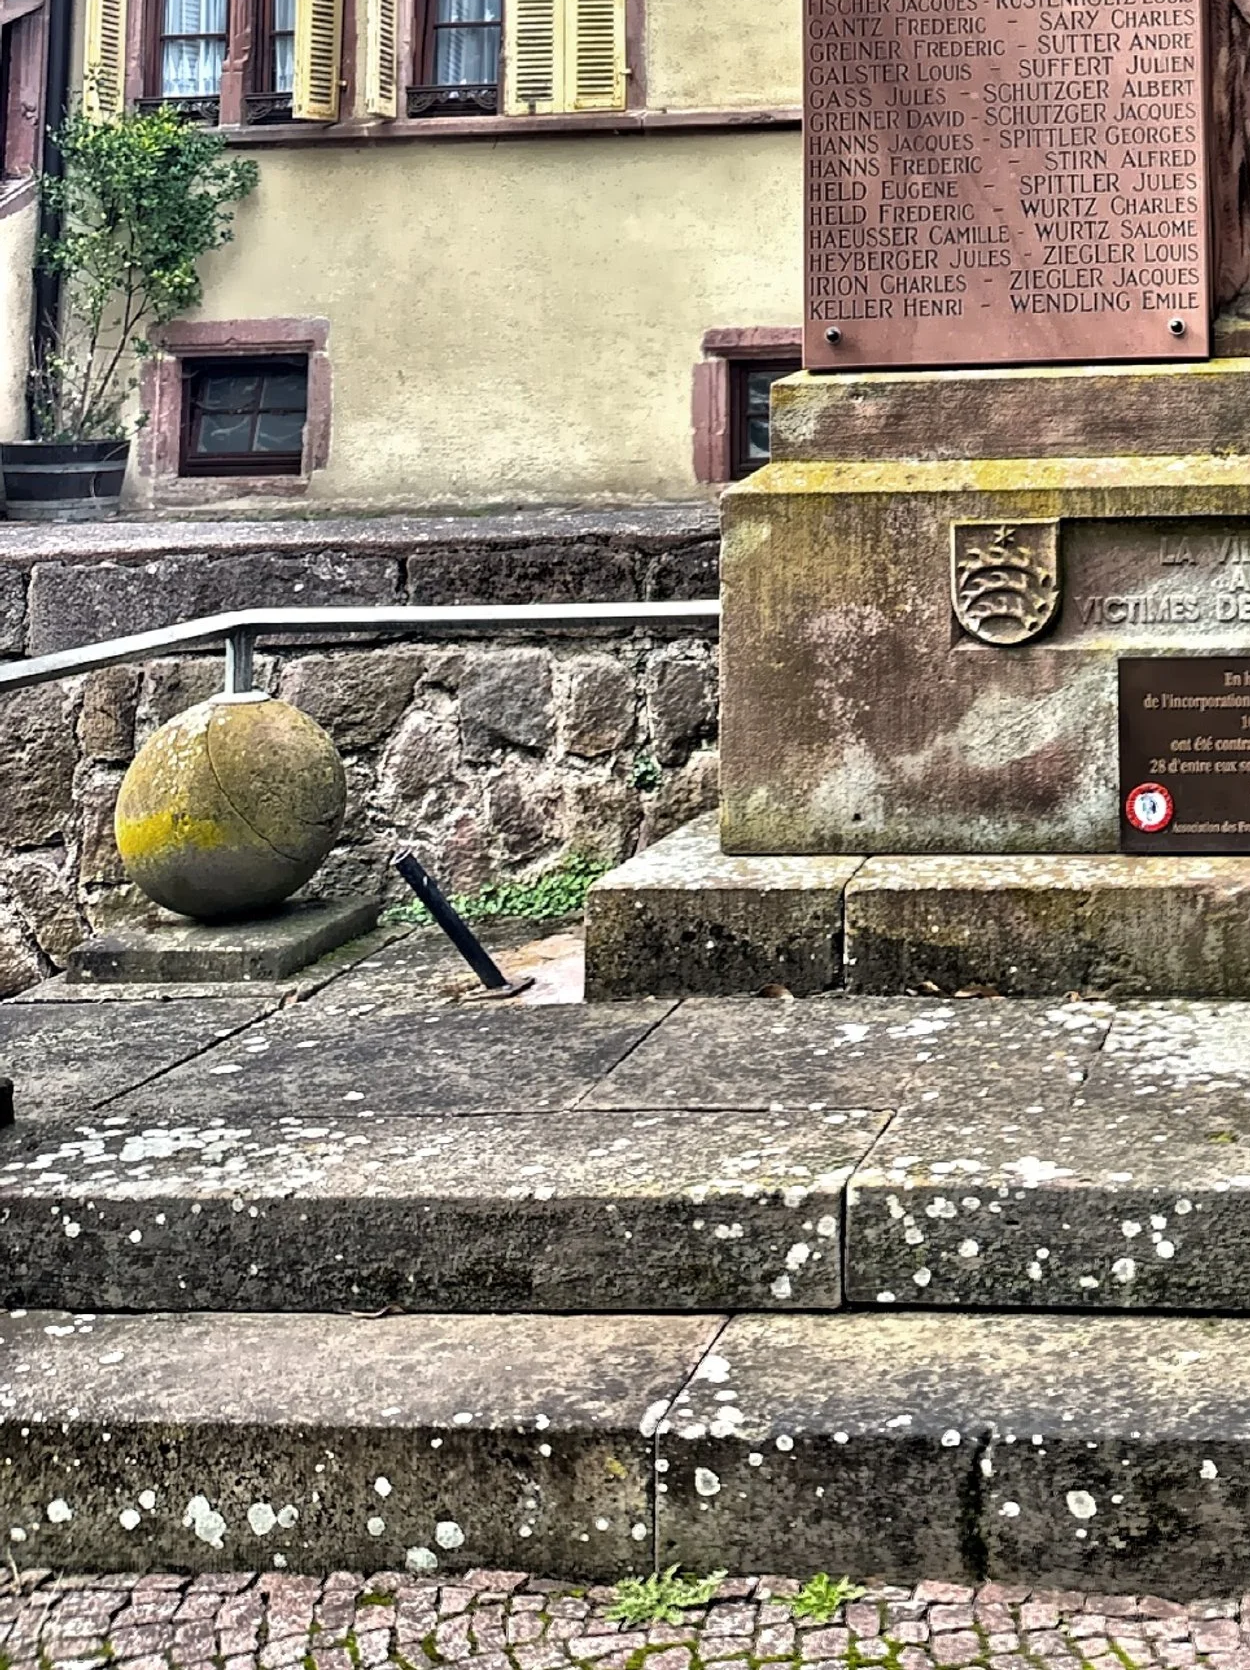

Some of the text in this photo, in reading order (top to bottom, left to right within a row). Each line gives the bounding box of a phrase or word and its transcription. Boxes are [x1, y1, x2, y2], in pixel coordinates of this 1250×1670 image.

[809, 8, 1194, 39] GANTZ FREDERIC SARY CHARLES
[810, 78, 1194, 109] GASS JULES SCHUTZGER ALBERT
[810, 149, 1195, 178] HANNS FREDERIC STIRN ALFRED
[810, 219, 1197, 249] HAEUSSER CAMILLE WURTZ SALOME
[810, 289, 1199, 319] KELLER HENRI WENDLING EMILE
[1076, 594, 1200, 624] VICTIMES
[1224, 671, 1241, 686] En
[1143, 693, 1159, 708] de
[1161, 692, 1250, 710] l'incorporation
[1170, 738, 1191, 751] ont
[1193, 735, 1212, 751] été
[1149, 758, 1166, 773] 28
[1167, 757, 1212, 773] d'entre
[1214, 761, 1237, 772] eux
